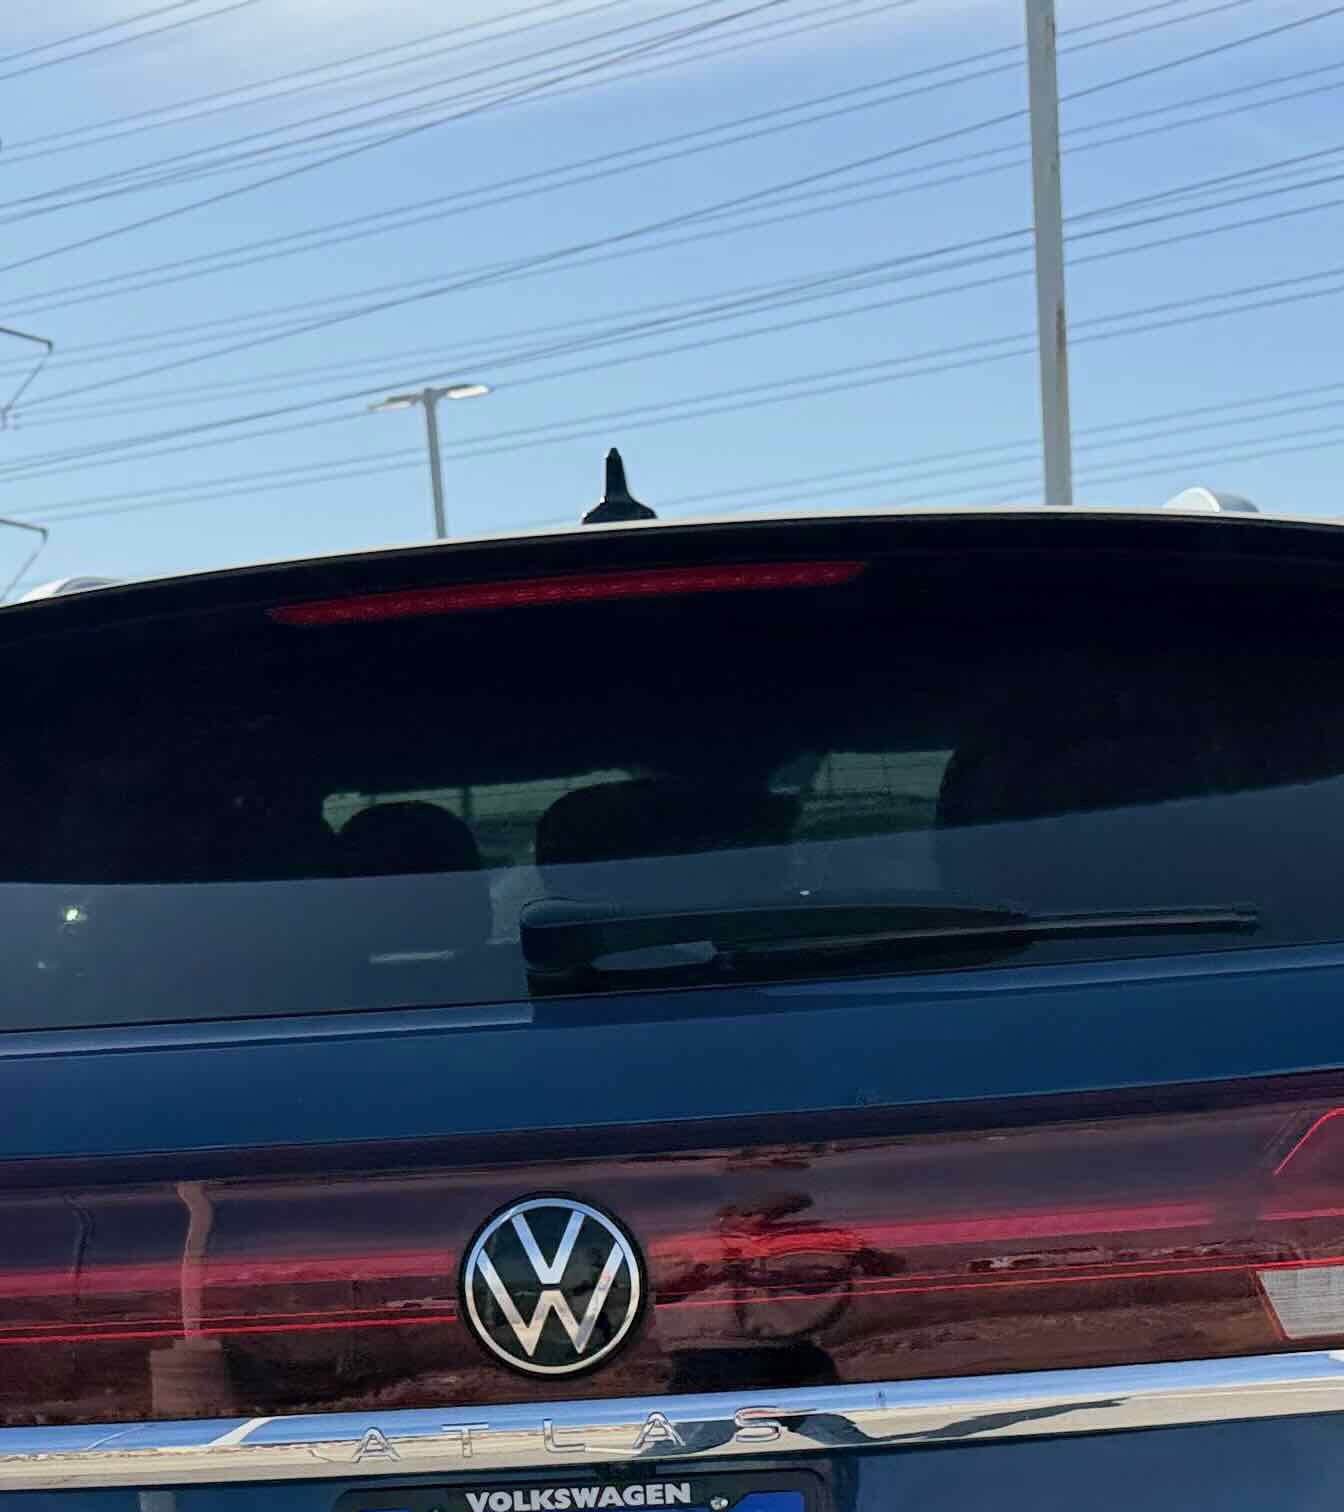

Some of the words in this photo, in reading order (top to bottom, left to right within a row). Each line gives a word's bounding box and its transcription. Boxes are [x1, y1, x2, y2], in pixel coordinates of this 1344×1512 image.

[470, 1205, 630, 1360] VW
[354, 1407, 782, 1462] ATLAS
[465, 1483, 691, 1512] VOLKSWAGEN
